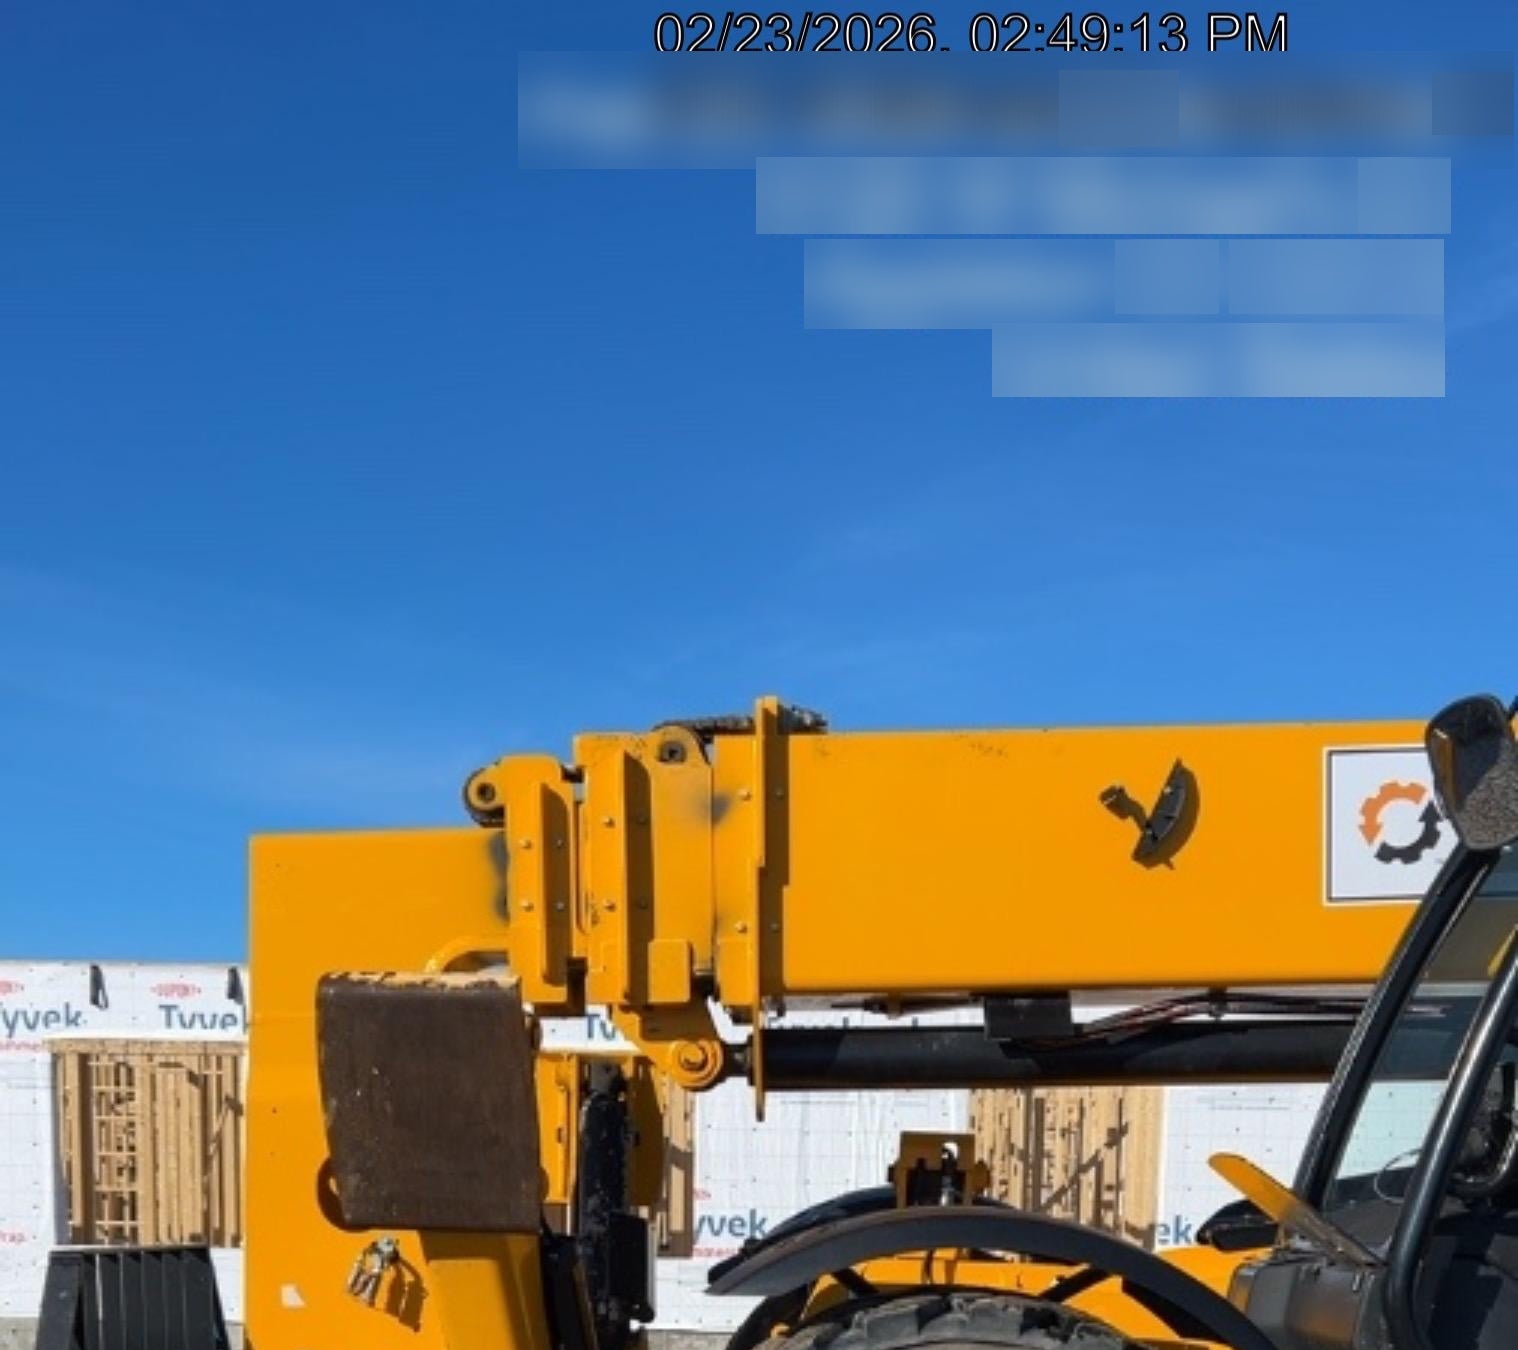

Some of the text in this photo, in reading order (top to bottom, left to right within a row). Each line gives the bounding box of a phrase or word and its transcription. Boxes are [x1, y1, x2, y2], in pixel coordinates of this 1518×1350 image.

[0, 1001, 82, 1038] yvek
[158, 1004, 247, 1031] Tyve
[694, 1208, 768, 1245] yvek
